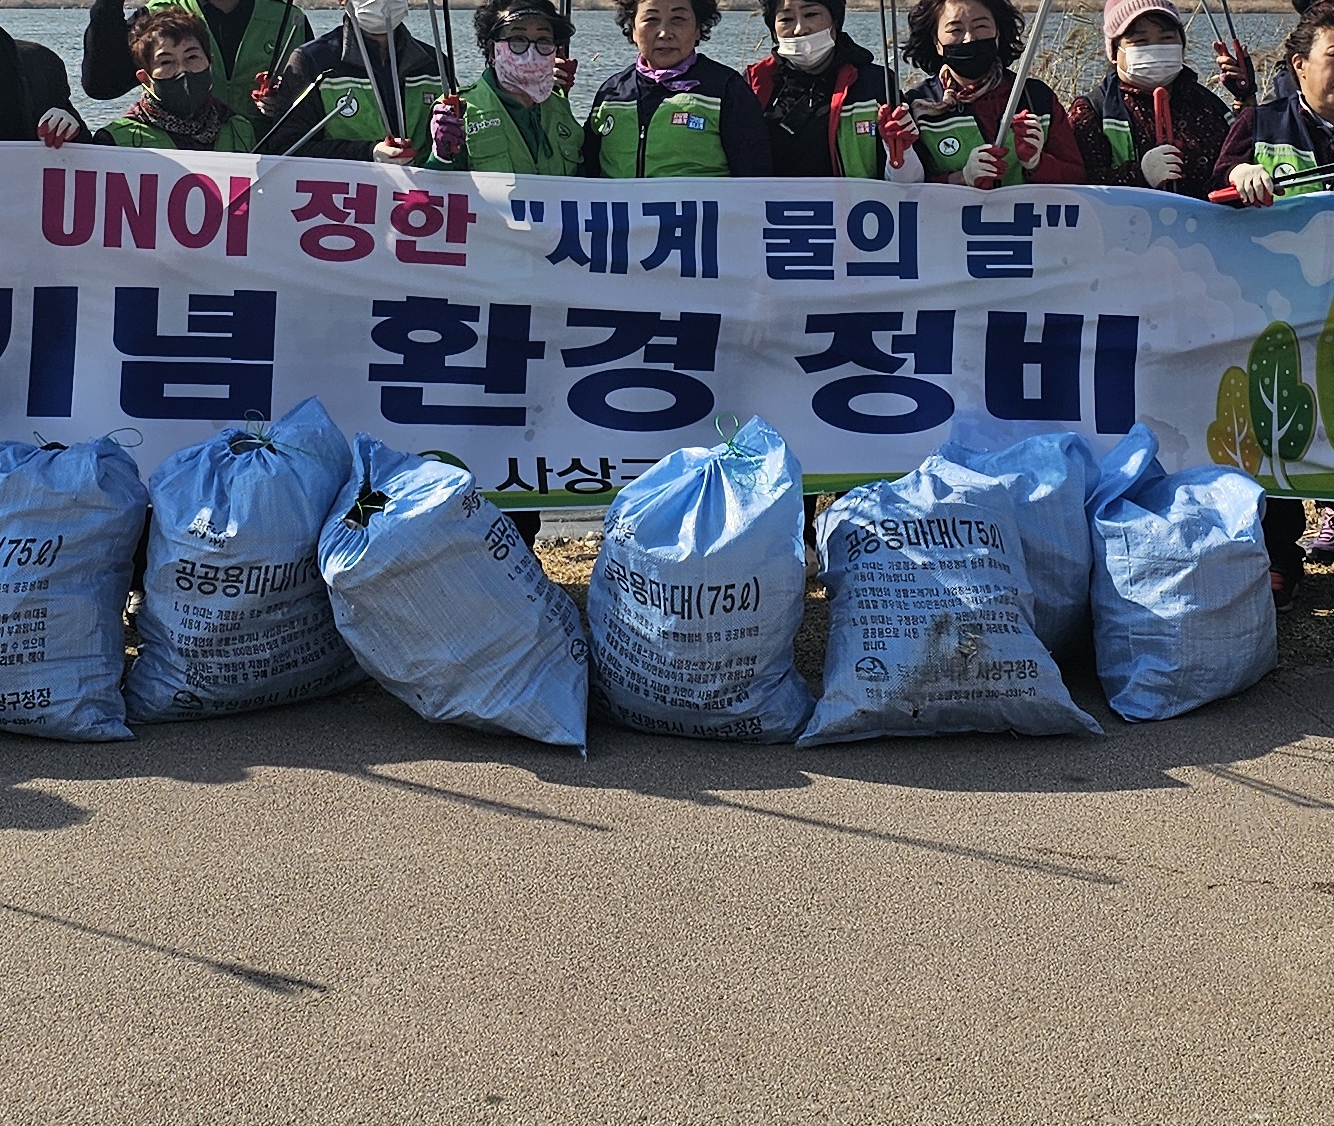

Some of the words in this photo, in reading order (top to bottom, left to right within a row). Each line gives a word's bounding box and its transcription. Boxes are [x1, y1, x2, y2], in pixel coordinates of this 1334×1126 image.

[42, 167, 252, 257] UN이
[291, 179, 477, 267] 정한
[511, 199, 720, 280] "세계
[762, 199, 919, 281] 물의
[961, 202, 1080, 279] 날"
[368, 295, 722, 432] 환경
[794, 309, 1140, 435] 정비
